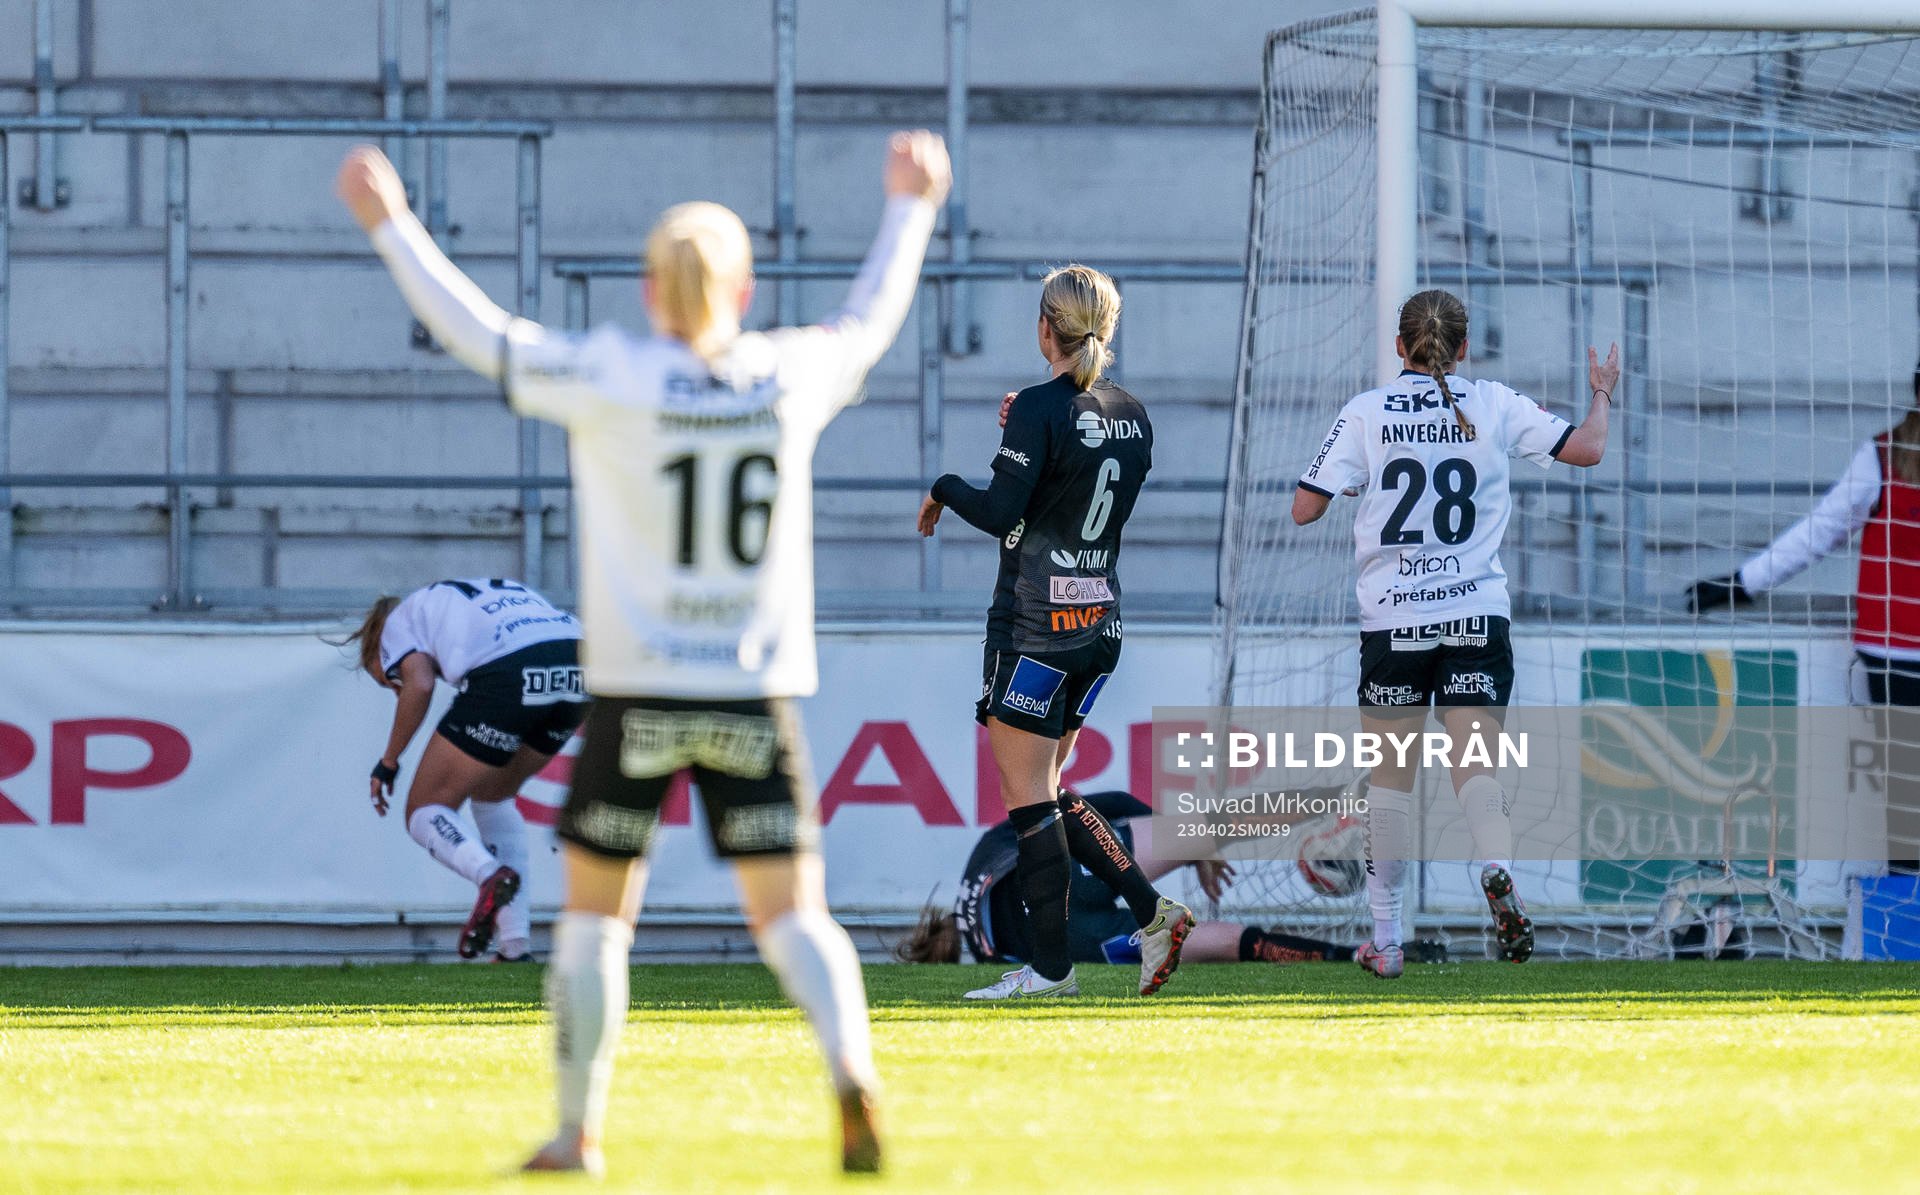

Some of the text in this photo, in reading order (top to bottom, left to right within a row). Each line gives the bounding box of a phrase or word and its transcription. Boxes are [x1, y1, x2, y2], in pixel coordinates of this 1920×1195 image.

[1384, 390, 1467, 413] SKF
[1102, 418, 1143, 440] VIDA
[1308, 418, 1347, 480] stadium
[660, 453, 779, 568] 16
[1080, 457, 1121, 542] 6
[1380, 457, 1478, 547] 28
[1399, 553, 1461, 577] brion
[1053, 580, 1109, 600] LOHILO
[1392, 580, 1478, 607] prefab syd
[1458, 636, 1489, 648] GROUP
[1370, 681, 1412, 696] NORDIC
[1450, 672, 1494, 687] NORDIC
[1006, 690, 1046, 714] ABENA
[1364, 687, 1423, 706] WELLNESS
[1079, 811, 1132, 873] KUNGSGRILLEN
